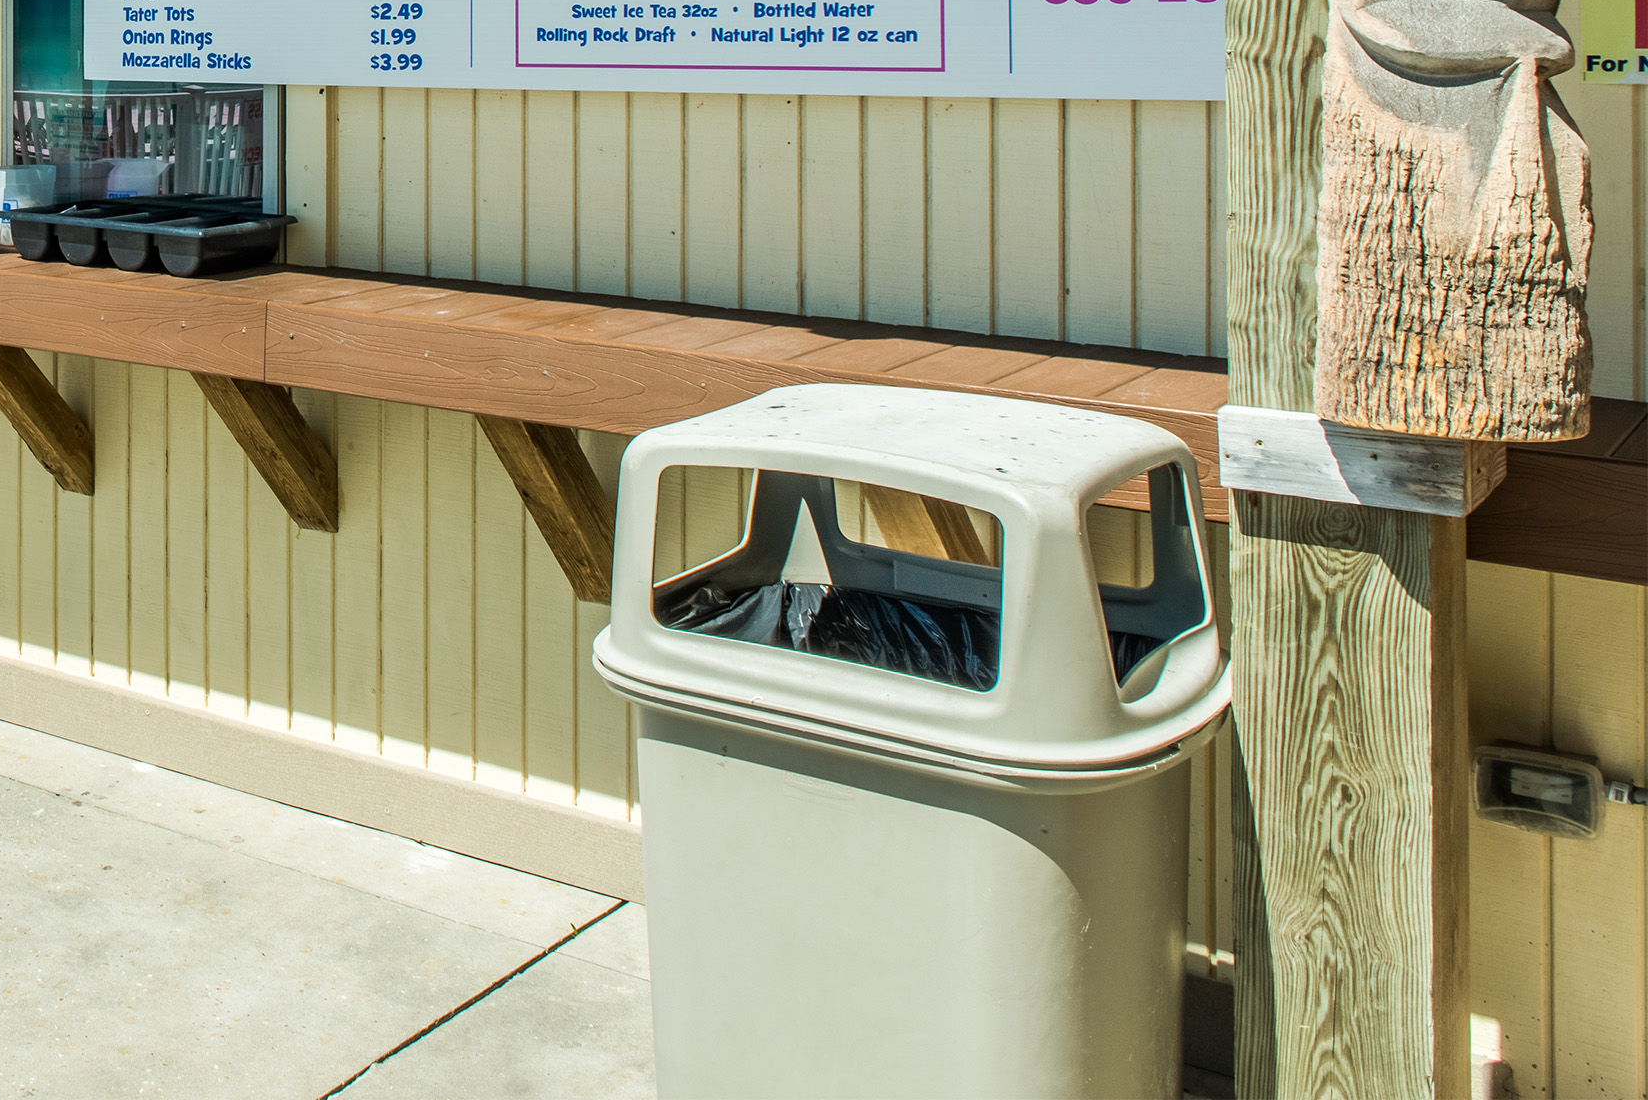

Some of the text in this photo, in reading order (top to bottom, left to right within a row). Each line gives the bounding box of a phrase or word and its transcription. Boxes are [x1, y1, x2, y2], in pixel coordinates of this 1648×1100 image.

[122, 28, 417, 51] Onion Rings $1.99
[122, 52, 423, 72] Mozzarella Sticks $3.99
[1587, 55, 1628, 72] For
